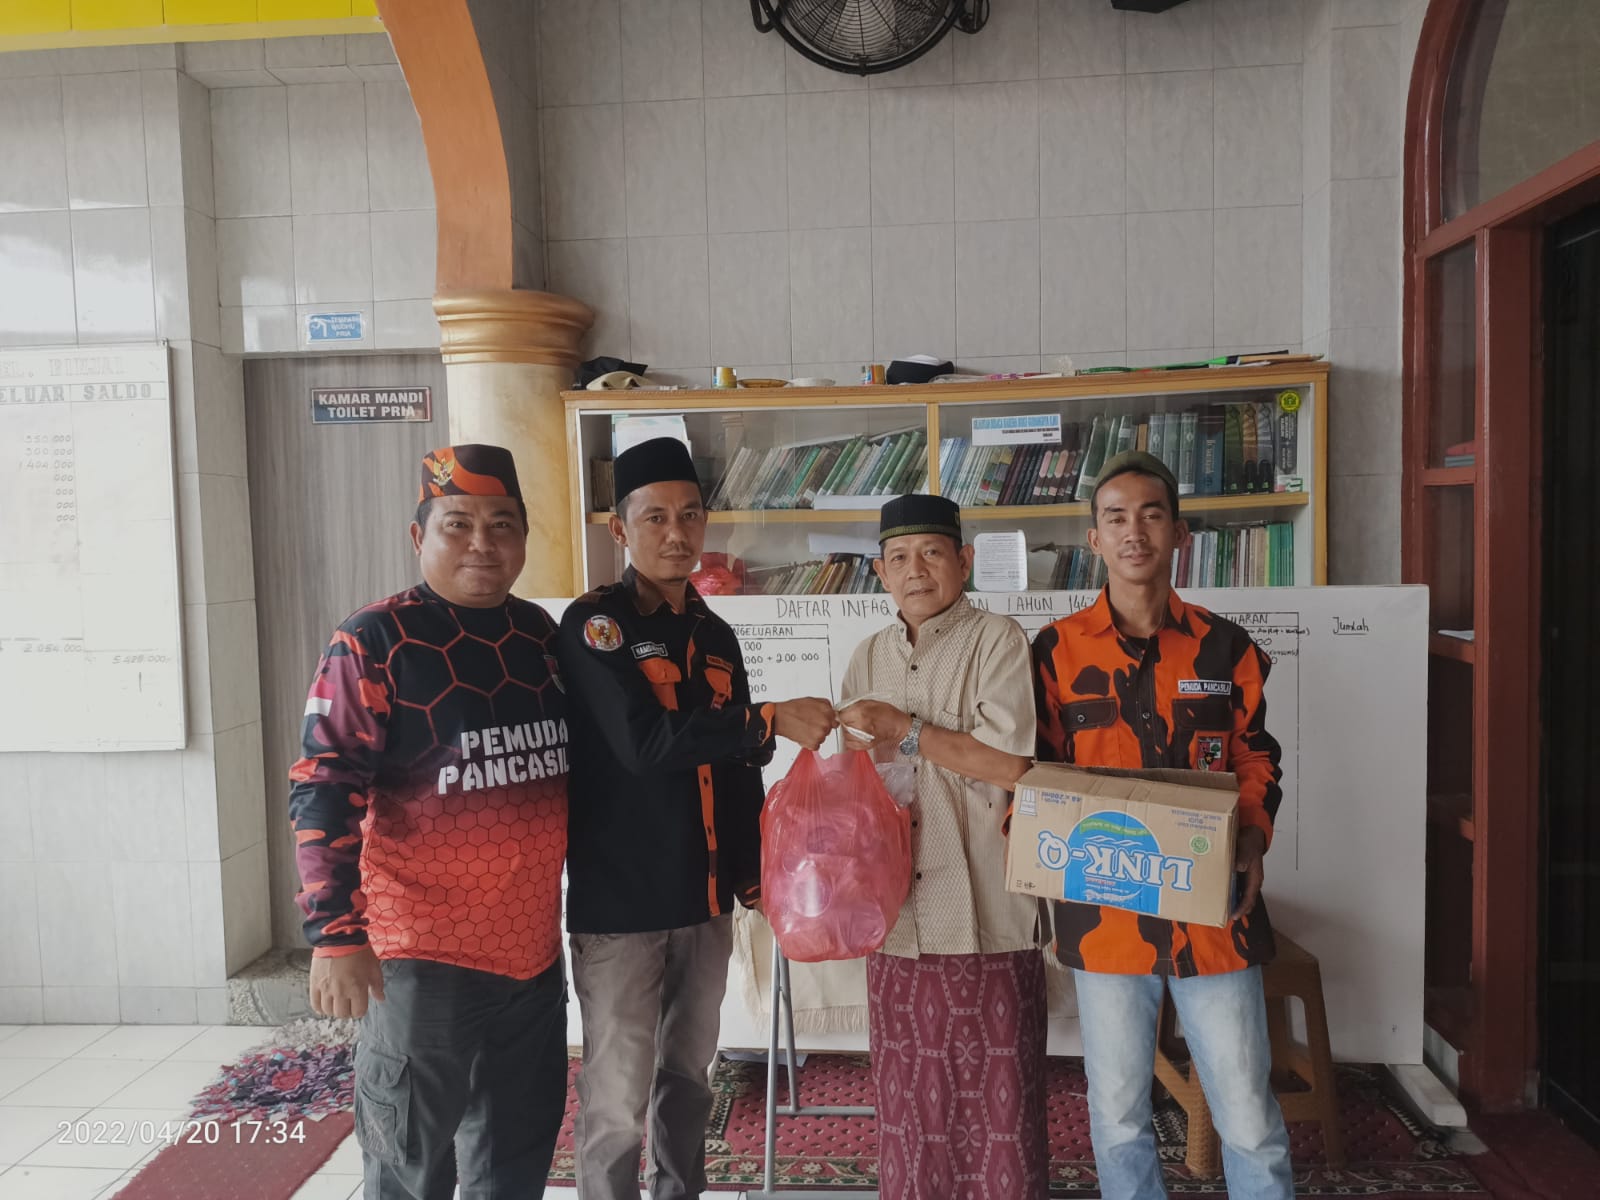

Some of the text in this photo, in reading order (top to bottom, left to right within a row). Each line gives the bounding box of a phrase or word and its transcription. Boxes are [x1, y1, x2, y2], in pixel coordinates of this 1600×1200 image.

[83, 384, 152, 401] SALDO
[318, 391, 423, 405] KAMAR MANDI
[327, 405, 416, 418] TOILET PRIA
[776, 598, 831, 619] DAFTAR
[744, 641, 762, 651] 000
[460, 717, 569, 760] PEMUDA
[1037, 830, 1194, 892] LINK-Q
